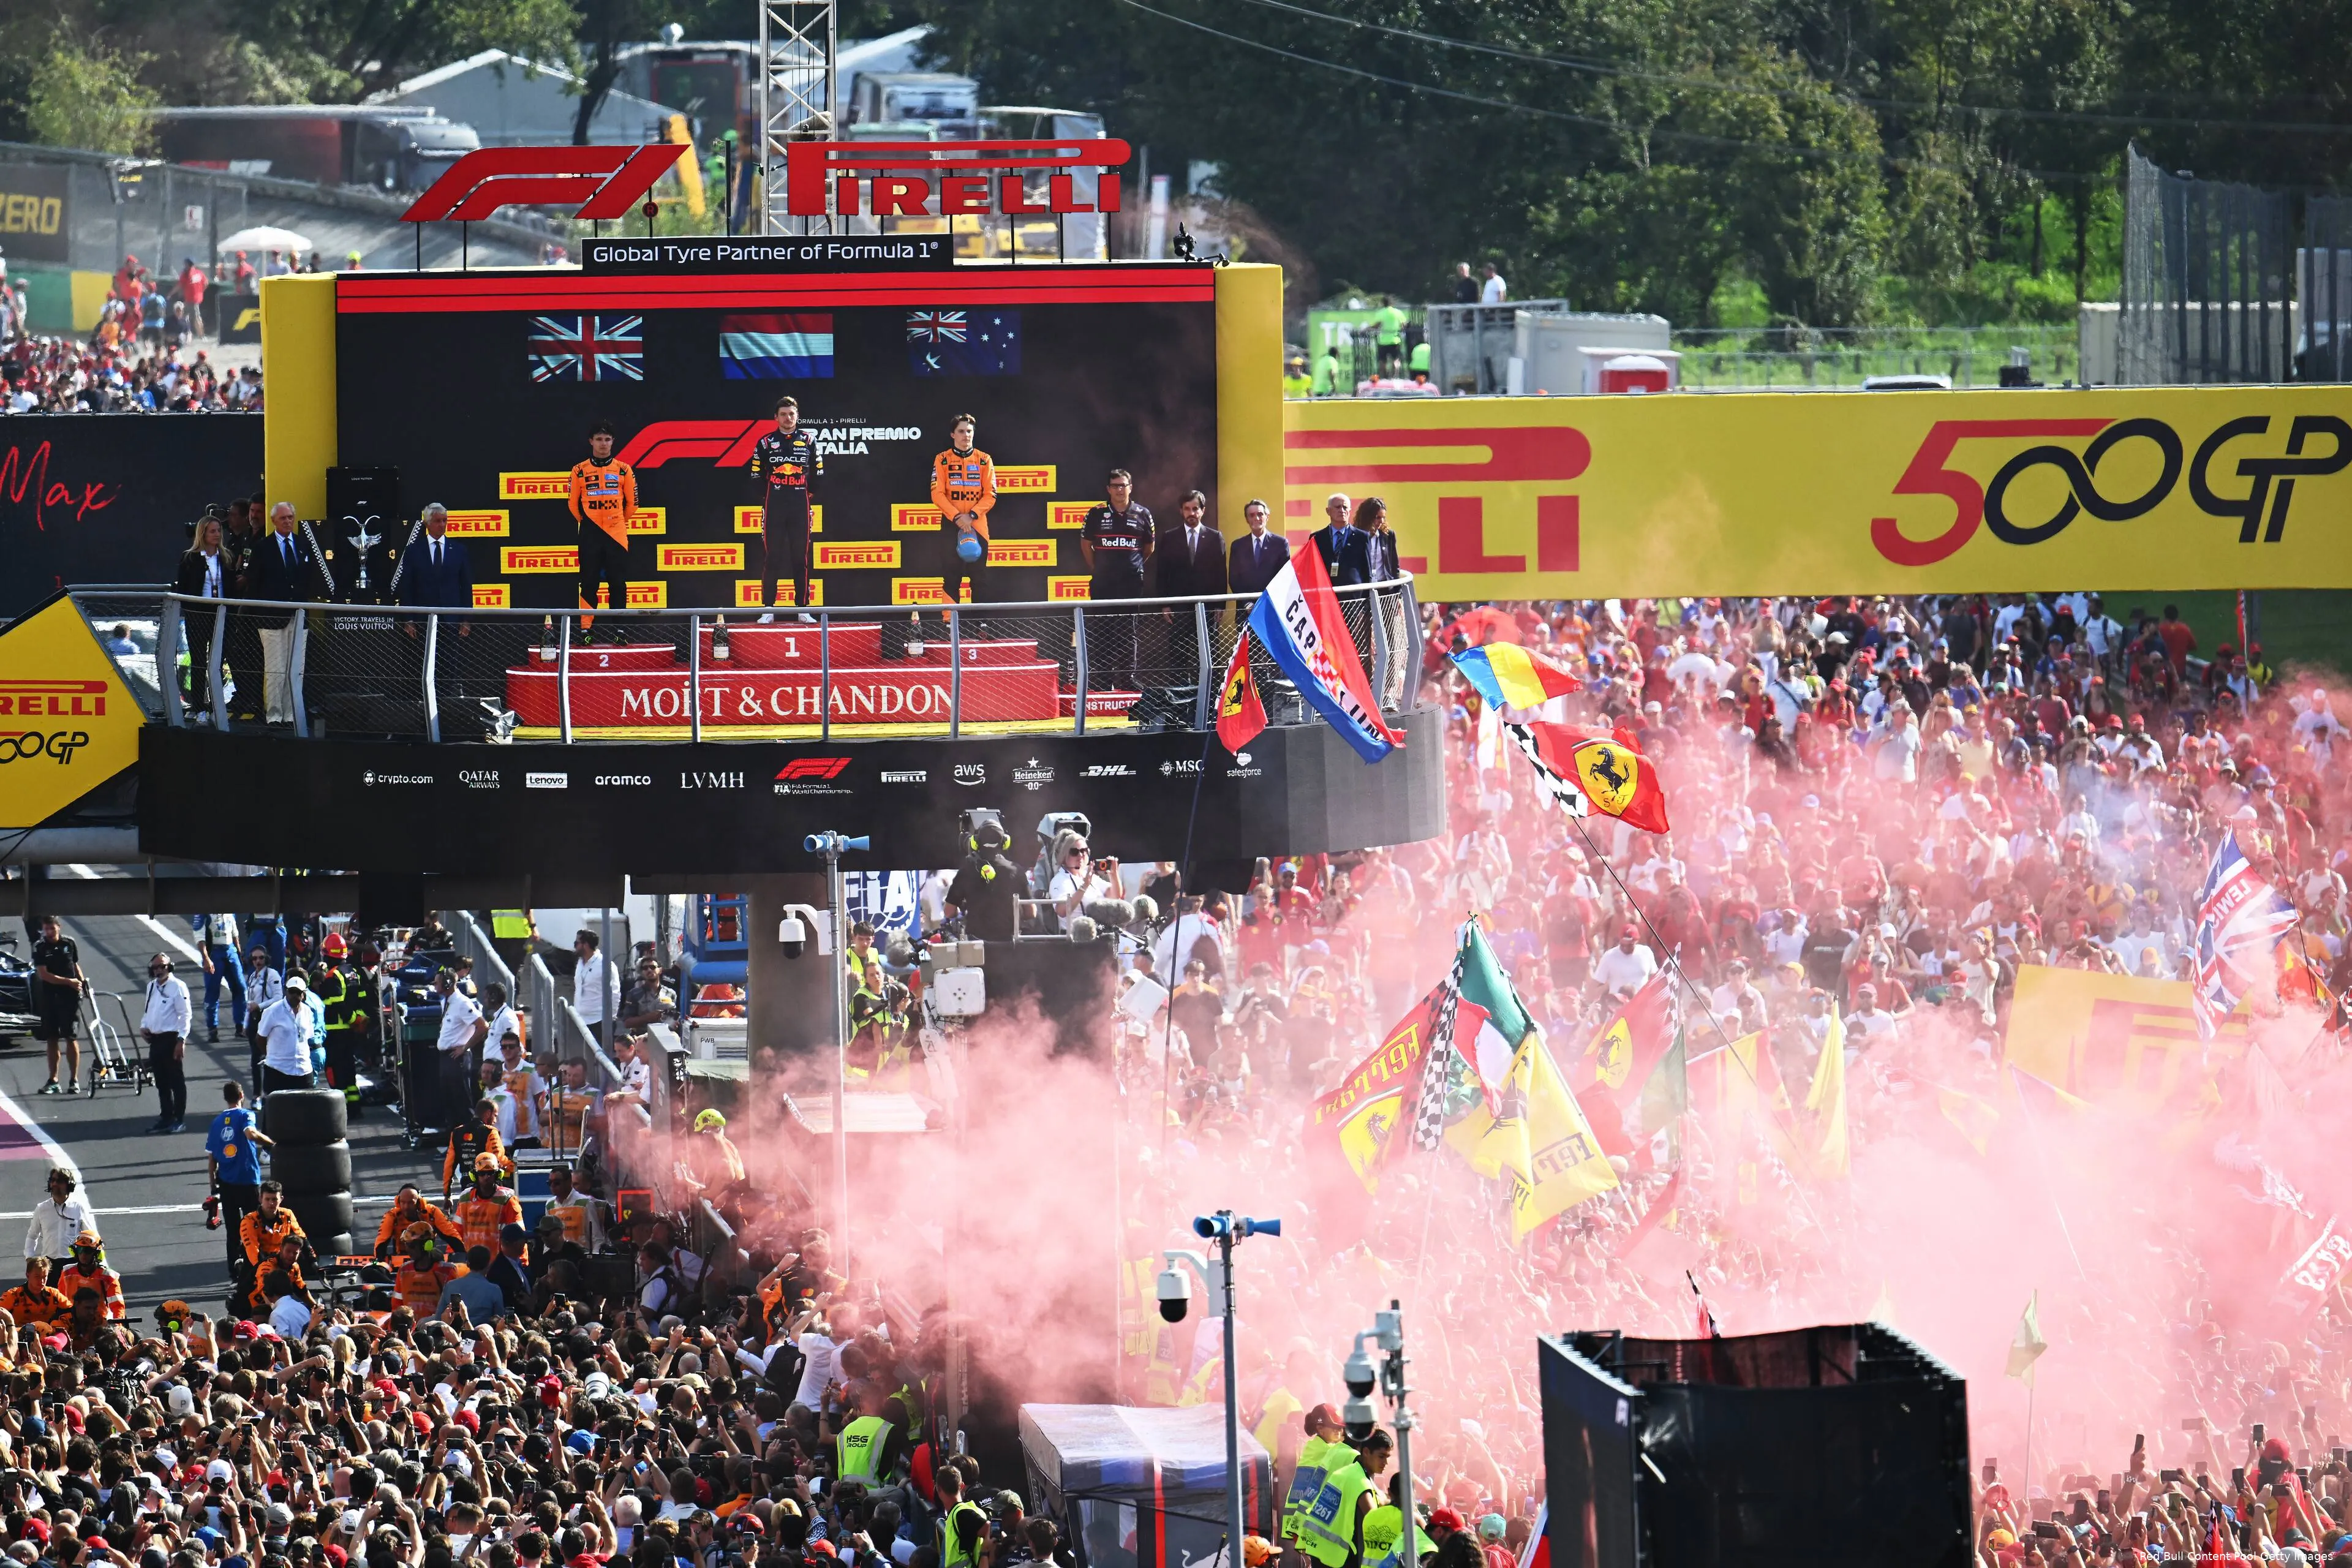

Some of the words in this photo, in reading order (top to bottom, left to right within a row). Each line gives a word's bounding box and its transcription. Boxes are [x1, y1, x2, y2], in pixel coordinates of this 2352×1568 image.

[399, 145, 690, 222] F1
[788, 138, 1132, 216] PIRELLI
[594, 246, 658, 262] Global
[664, 245, 710, 263] Tyre
[717, 244, 794, 261] Partner
[800, 244, 822, 260] of
[828, 243, 913, 260] Formula
[798, 428, 848, 441] RAN
[850, 427, 921, 441] PREMIO
[614, 420, 778, 469] F1
[816, 442, 869, 454] TALIA
[771, 475, 788, 484] Red
[789, 475, 805, 485] Bull
[1102, 538, 1119, 546] Red
[1120, 538, 1137, 548] Bull
[664, 548, 737, 565] PIRELLI
[821, 546, 893, 564] PIRELLI
[785, 638, 800, 657] 1
[600, 654, 609, 667] 2
[968, 649, 977, 660] 3
[739, 687, 764, 717] &
[774, 758, 853, 779] F1
[954, 764, 985, 777] aws
[1014, 770, 1052, 780] Heineken
[1087, 764, 1129, 777] DHL
[1227, 767, 1262, 778] salesforce
[378, 774, 433, 785] crypto.com
[459, 770, 499, 782] QATAR
[529, 775, 564, 785] Lenovo
[595, 775, 652, 785] aramco
[680, 772, 745, 788] LVMH
[881, 771, 927, 783] PIRELLI
[774, 784, 791, 794] FIA
